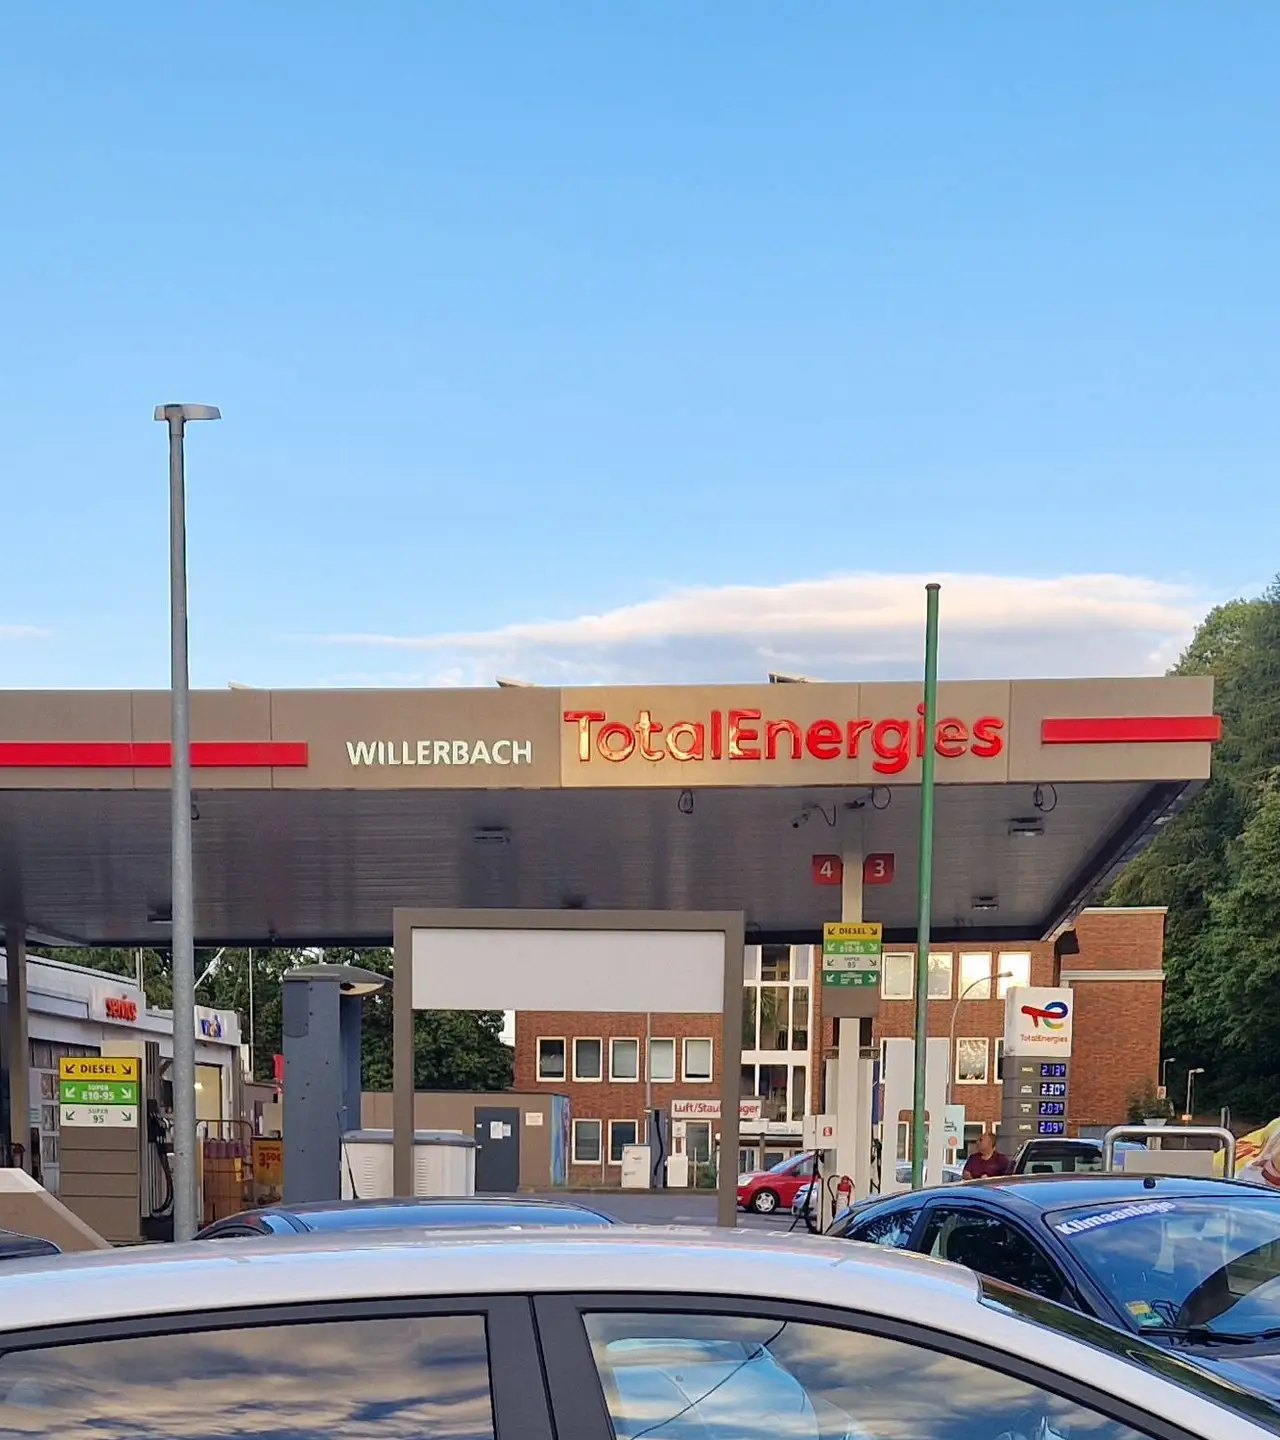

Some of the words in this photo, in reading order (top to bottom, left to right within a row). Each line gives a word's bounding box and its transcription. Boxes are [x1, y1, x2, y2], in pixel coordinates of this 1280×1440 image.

[563, 703, 1005, 775] TotalEnergies
[346, 740, 532, 765] WILLERBACH
[820, 860, 834, 878] 4
[873, 860, 886, 878] 3
[839, 927, 867, 935] DIESEL
[1021, 1033, 1068, 1044] TotalEnergies
[80, 1064, 117, 1074] DIESEL
[82, 1091, 115, 1101] E10-95
[92, 1114, 105, 1123] 95
[1054, 1201, 1177, 1235] Klimaanlage
